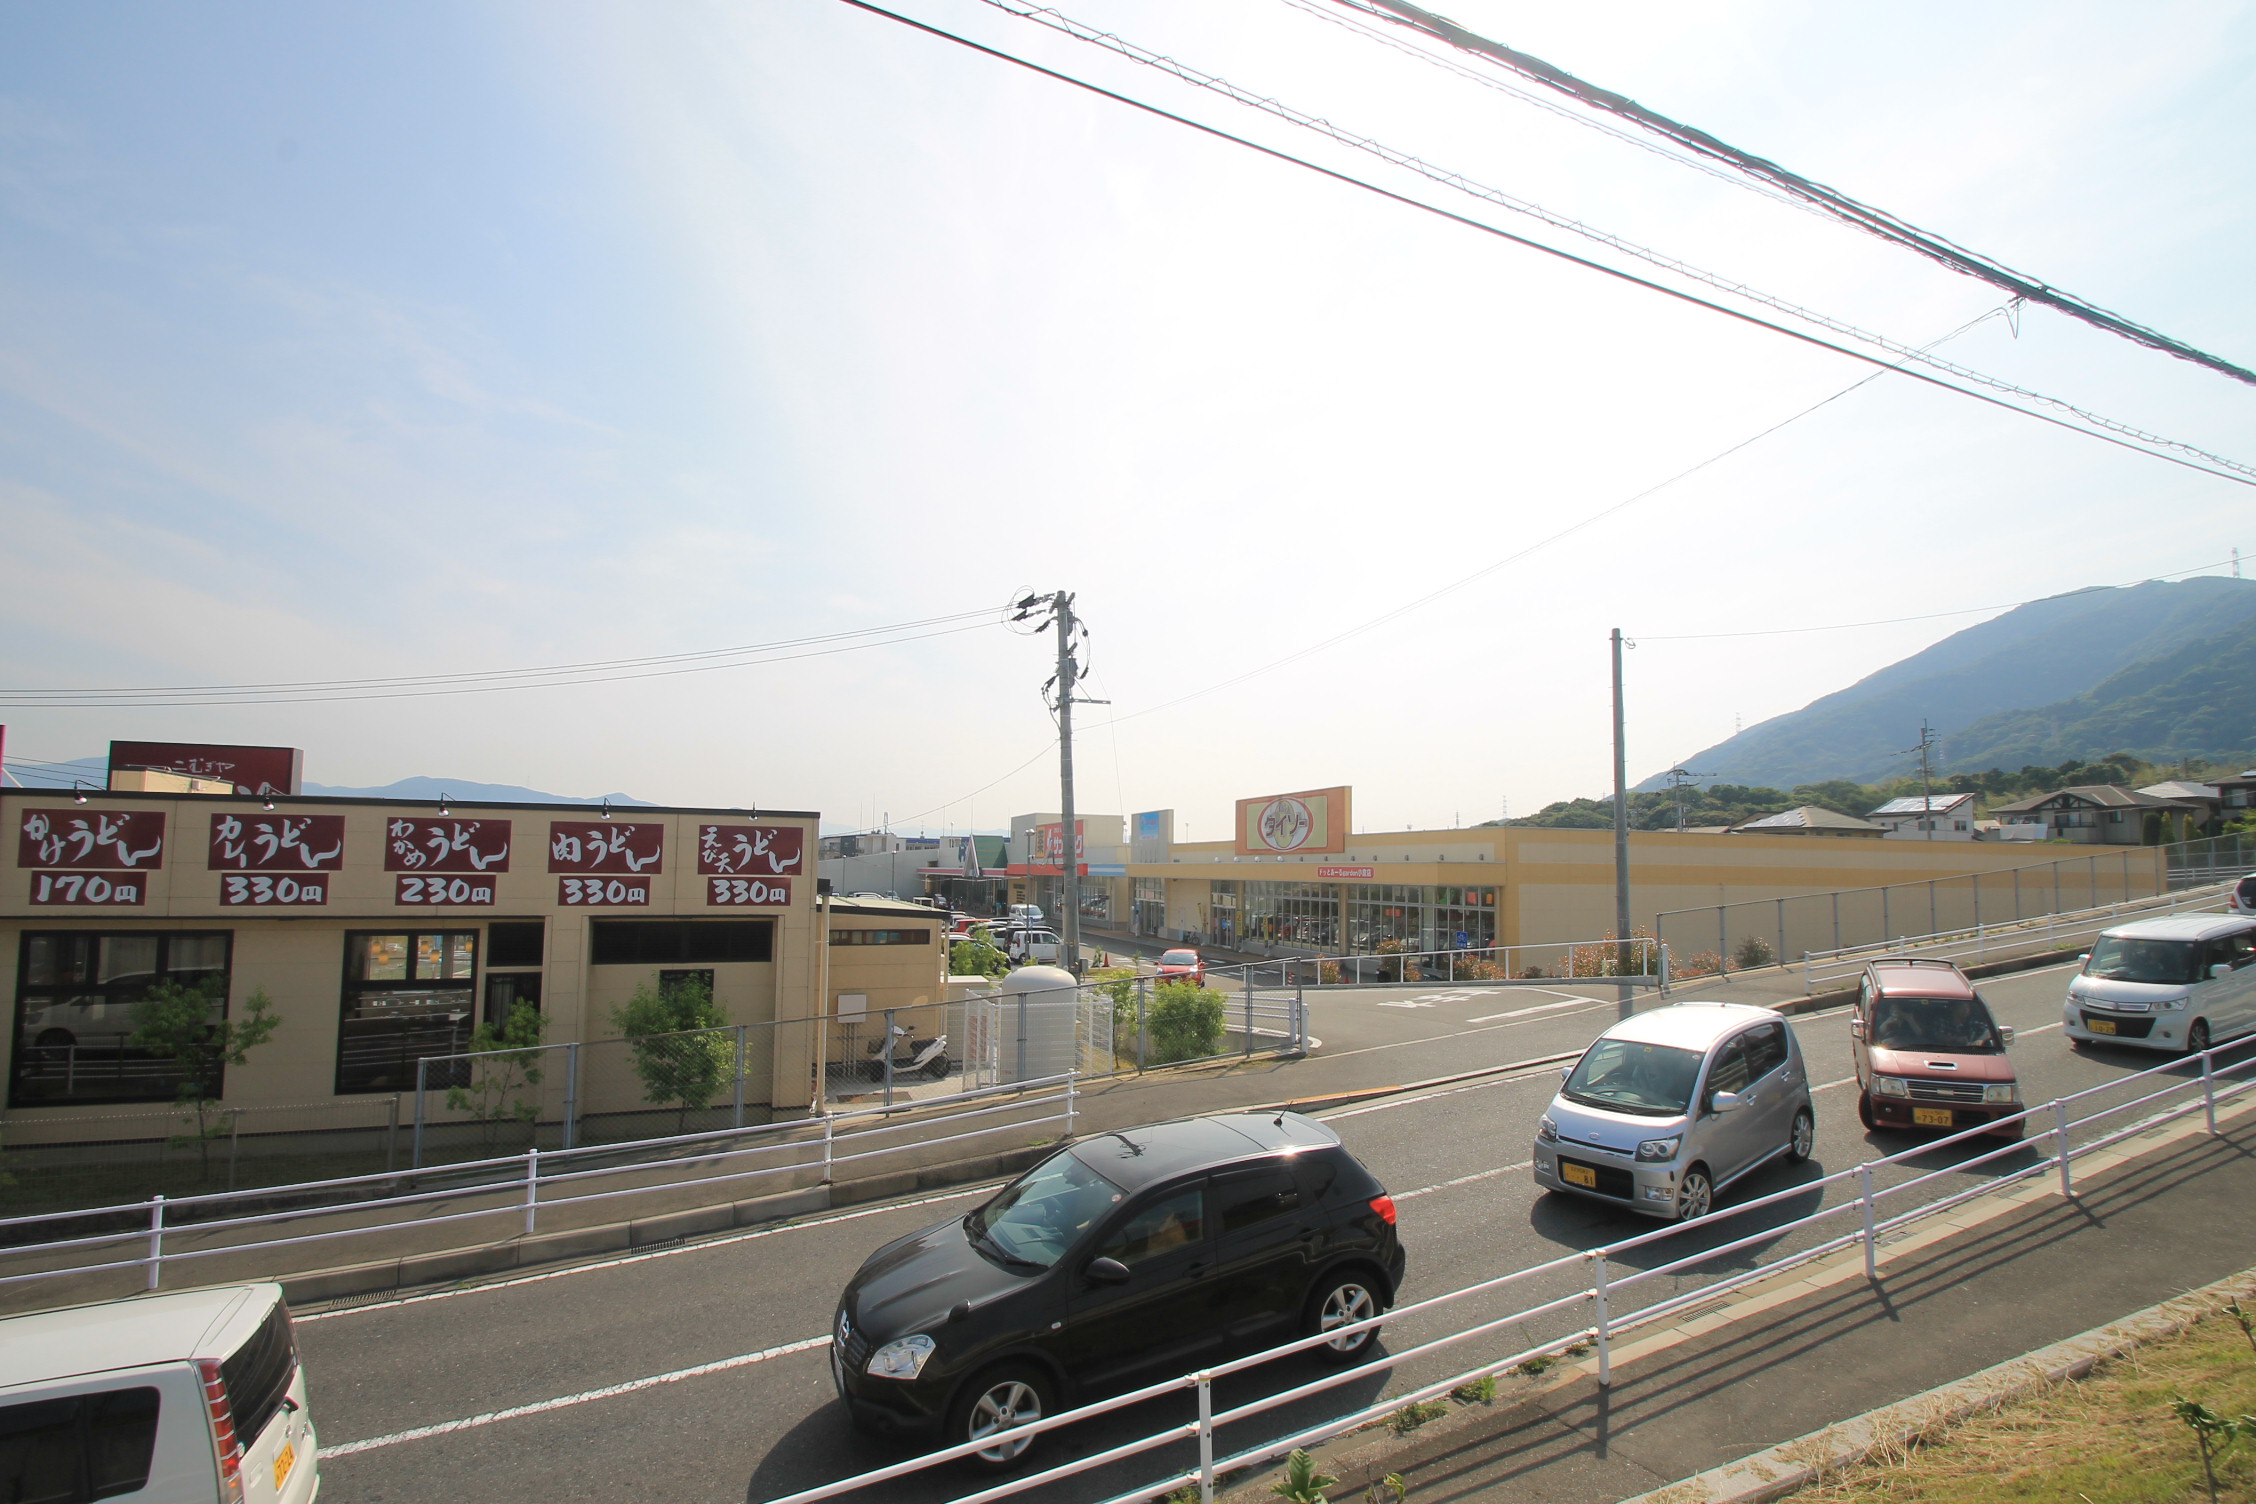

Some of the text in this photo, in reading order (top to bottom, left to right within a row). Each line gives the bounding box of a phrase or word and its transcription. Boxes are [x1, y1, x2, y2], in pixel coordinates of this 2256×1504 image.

[24, 813, 161, 866] かけうどん
[214, 815, 342, 868] カレーうどん
[389, 819, 508, 870] わかめうどん
[552, 825, 660, 872] 肉うどん
[701, 826, 801, 874] えび天うどん
[36, 874, 137, 902] 170円
[225, 876, 323, 903] 330円
[401, 878, 491, 904] 230円
[562, 878, 646, 904] 330円
[712, 879, 786, 904] 330円
